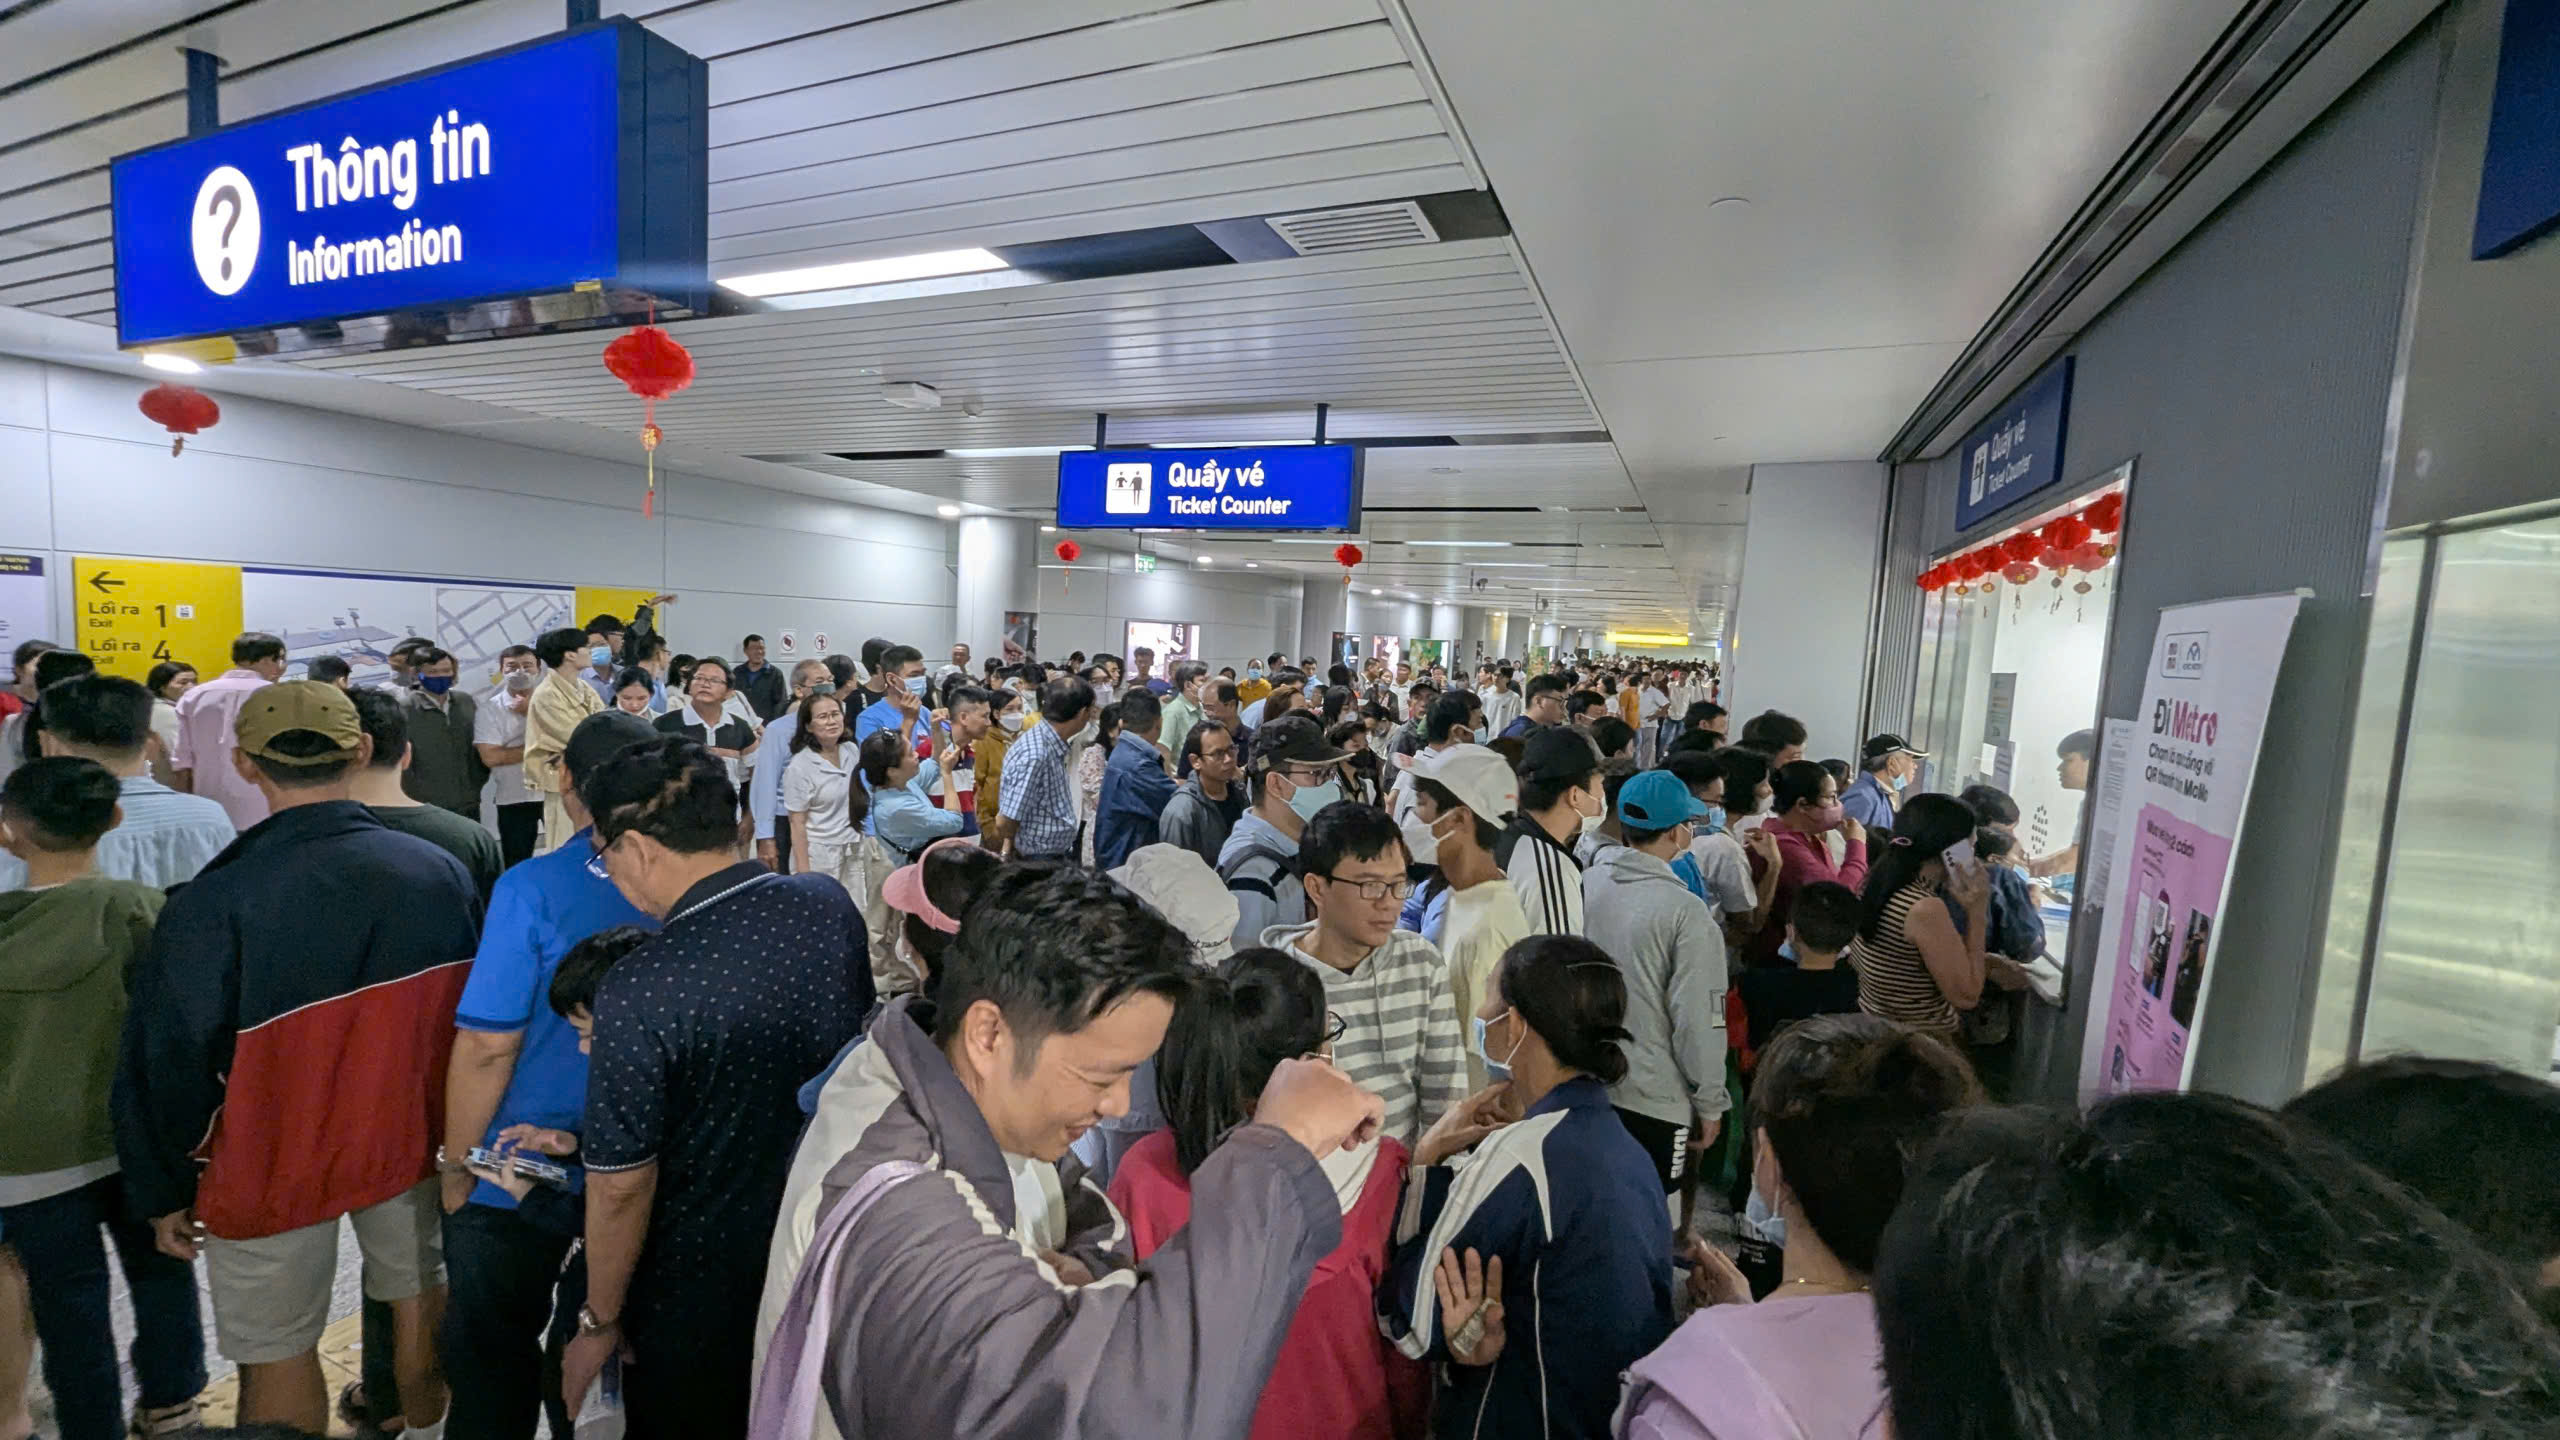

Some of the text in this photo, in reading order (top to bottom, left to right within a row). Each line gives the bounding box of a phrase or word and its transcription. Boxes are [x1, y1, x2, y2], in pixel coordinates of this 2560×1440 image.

[286, 109, 490, 212] Thông tin
[288, 217, 462, 286] Information
[1168, 458, 1265, 493] Quầy vé
[1167, 495, 1292, 515] Ticket Counter
[88, 600, 167, 628] Lối ra 1
[89, 618, 112, 628] Exit
[90, 637, 172, 662] Lối ra 4
[2172, 700, 2218, 747] Metro
